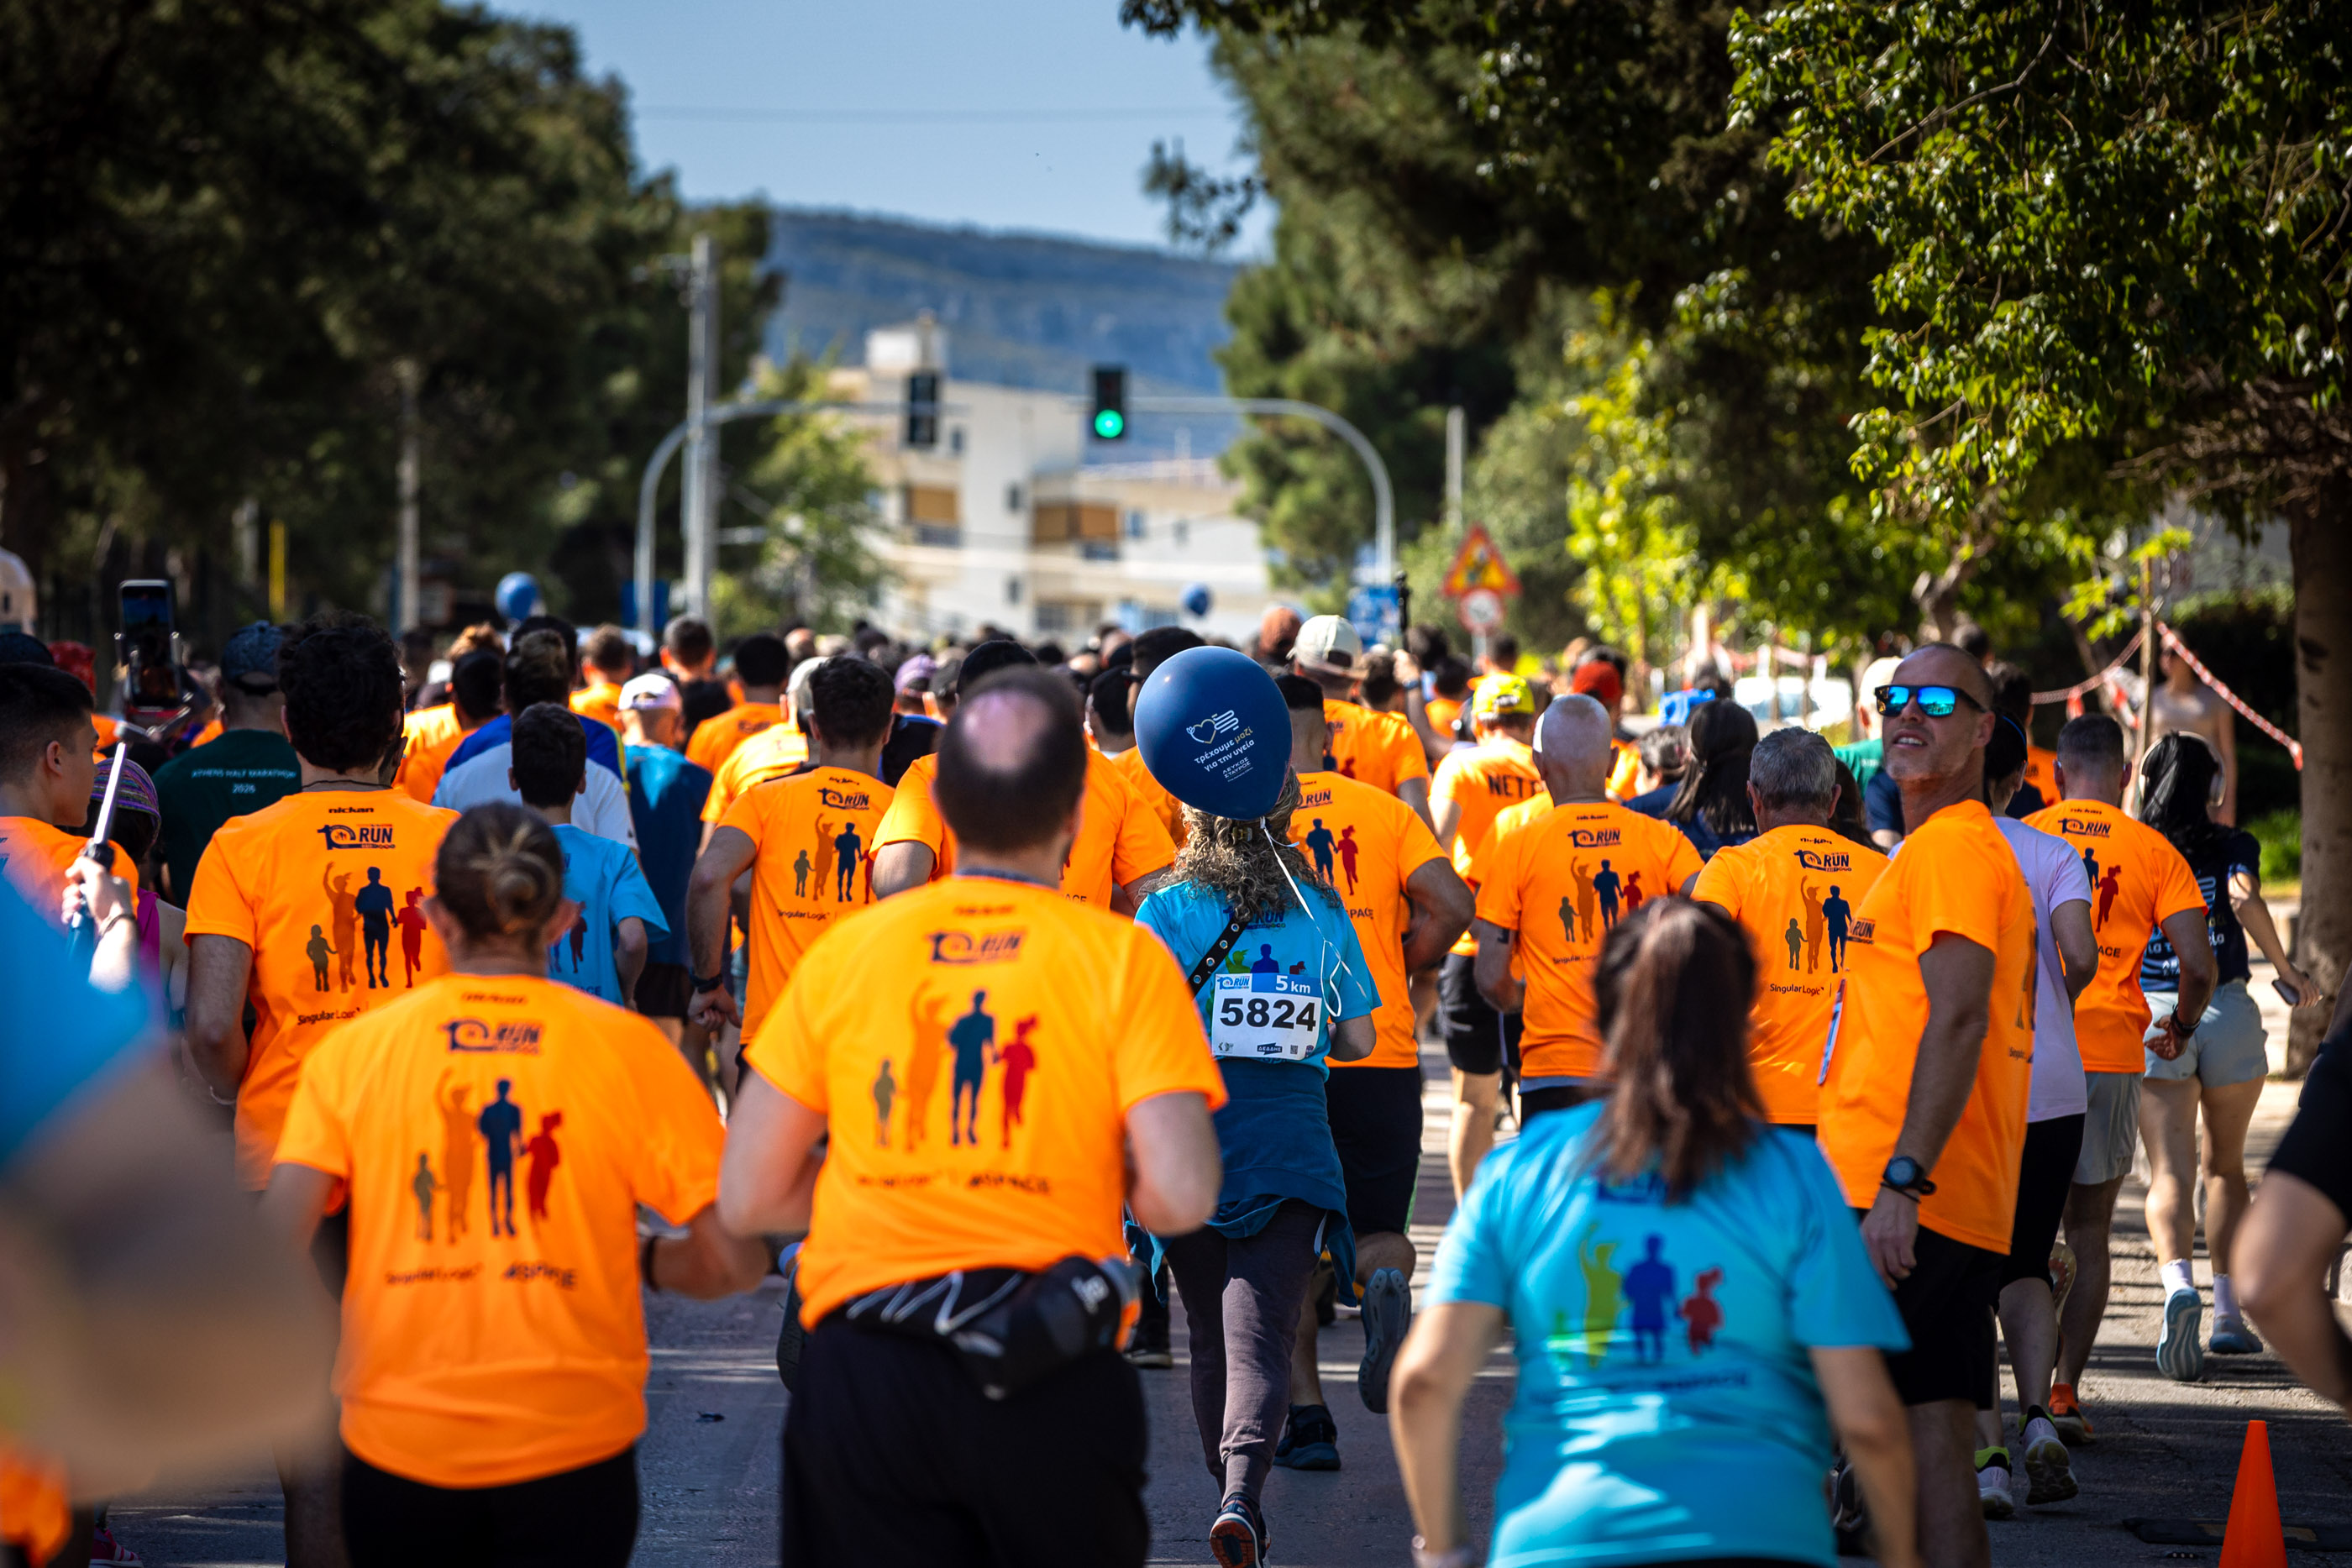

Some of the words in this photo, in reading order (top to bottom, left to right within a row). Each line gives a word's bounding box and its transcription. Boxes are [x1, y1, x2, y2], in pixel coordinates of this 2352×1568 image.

[1194, 739, 1235, 763] τρέχουμε
[1204, 760, 1218, 772] για
[1217, 753, 1232, 764] την
[1232, 739, 1255, 756] υγεία
[192, 768, 223, 779] ATHENS
[225, 768, 246, 778] HALF
[248, 768, 297, 779] MARATHON
[1222, 757, 1249, 774] ΛΕΥΚΟΣ
[1224, 761, 1252, 779] ΣΤΑΥΡΟΣ
[1305, 789, 1331, 804] RUN
[359, 827, 393, 843] RUN
[1596, 827, 1621, 843] RUN
[2086, 821, 2113, 835] RUN
[1823, 853, 1850, 868] RUN
[1233, 977, 1250, 986] RUN
[1275, 974, 1289, 992] 5
[1290, 980, 1311, 994] km
[1220, 997, 1317, 1032] 5824
